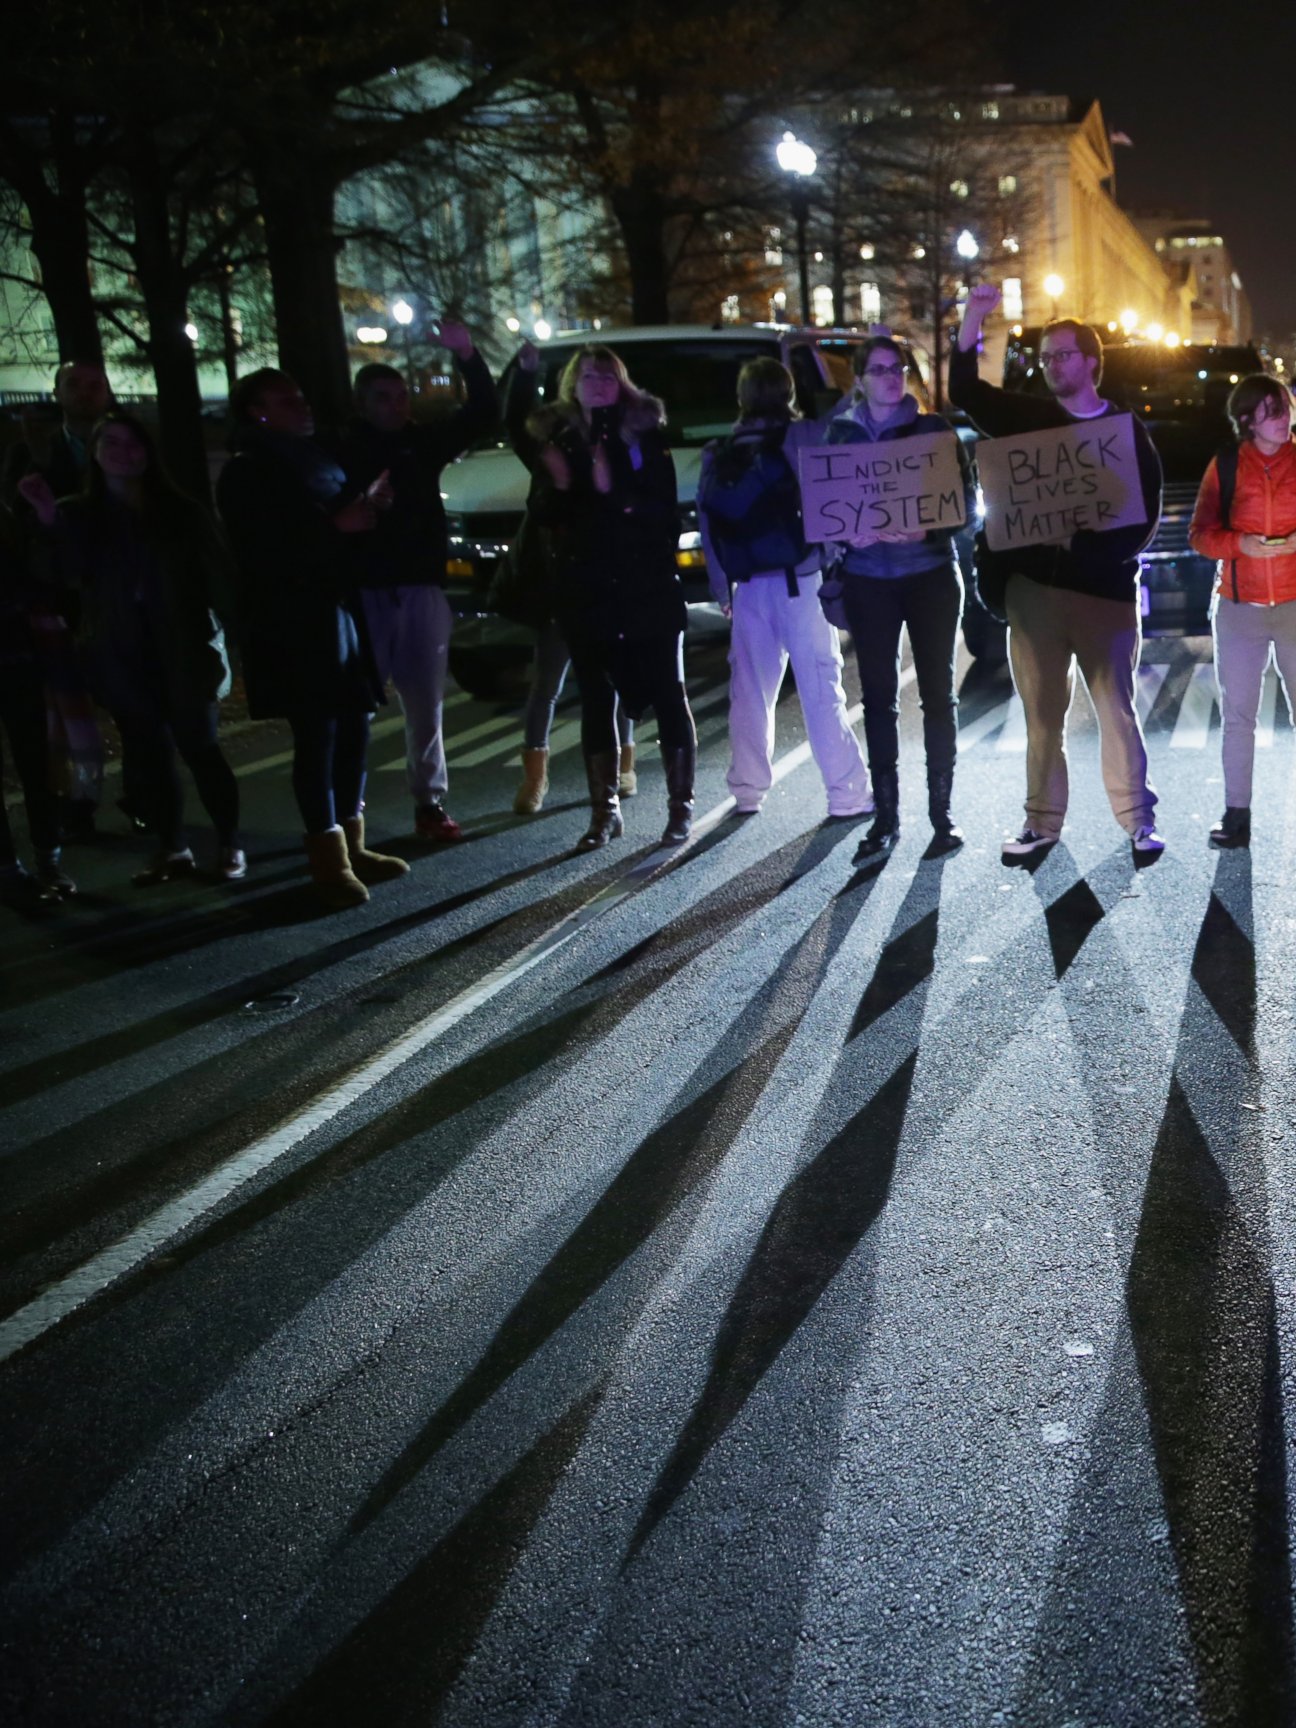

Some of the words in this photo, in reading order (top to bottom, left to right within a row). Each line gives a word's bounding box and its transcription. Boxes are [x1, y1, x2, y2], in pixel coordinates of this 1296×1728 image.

[810, 452, 938, 483] INDICT
[1007, 433, 1122, 486] BLACK
[860, 480, 900, 495] THE
[1009, 473, 1099, 507] LIVES
[819, 489, 963, 537] SYSTEM
[1004, 500, 1120, 541] MATTER
